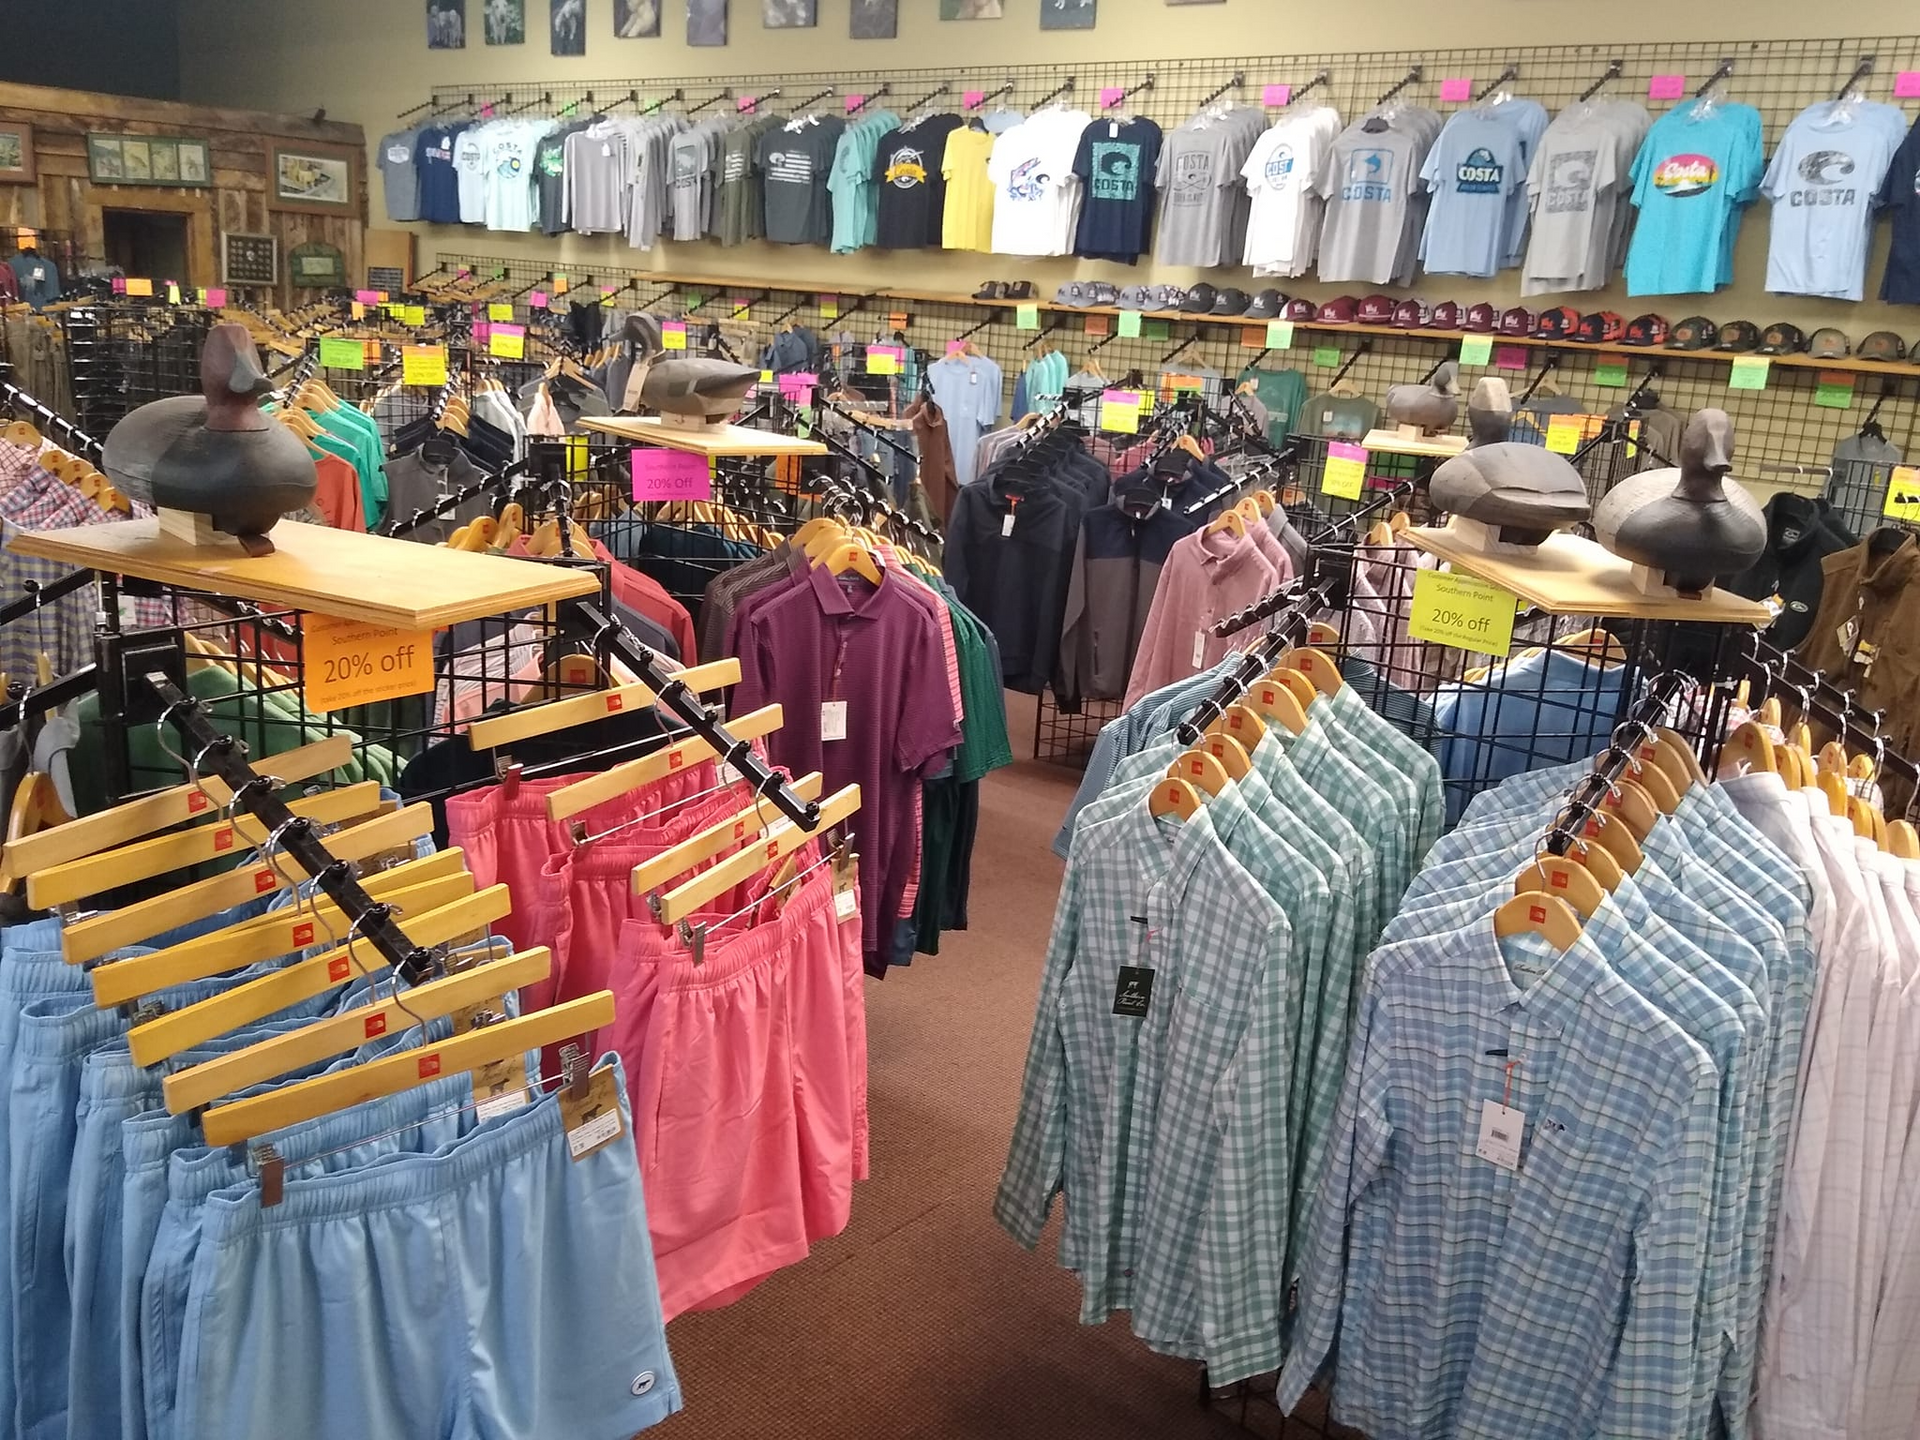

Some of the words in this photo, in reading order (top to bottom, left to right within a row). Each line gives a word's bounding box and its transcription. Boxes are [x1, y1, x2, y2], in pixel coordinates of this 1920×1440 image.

[1458, 166, 1500, 182] COSTA
[1664, 161, 1708, 178] Costa
[1094, 178, 1134, 192] COSTA
[1342, 186, 1392, 203] COSTA
[1790, 188, 1856, 208] COSTA
[647, 478, 672, 490] 20%
[675, 477, 693, 489] Off
[1436, 584, 1472, 598] Southern
[1473, 591, 1494, 603] Point
[1432, 608, 1464, 628] 20%
[1467, 617, 1491, 633] off
[332, 631, 372, 646] Southern
[373, 627, 398, 639] Point
[324, 652, 374, 684] 20%
[381, 644, 415, 672] off
